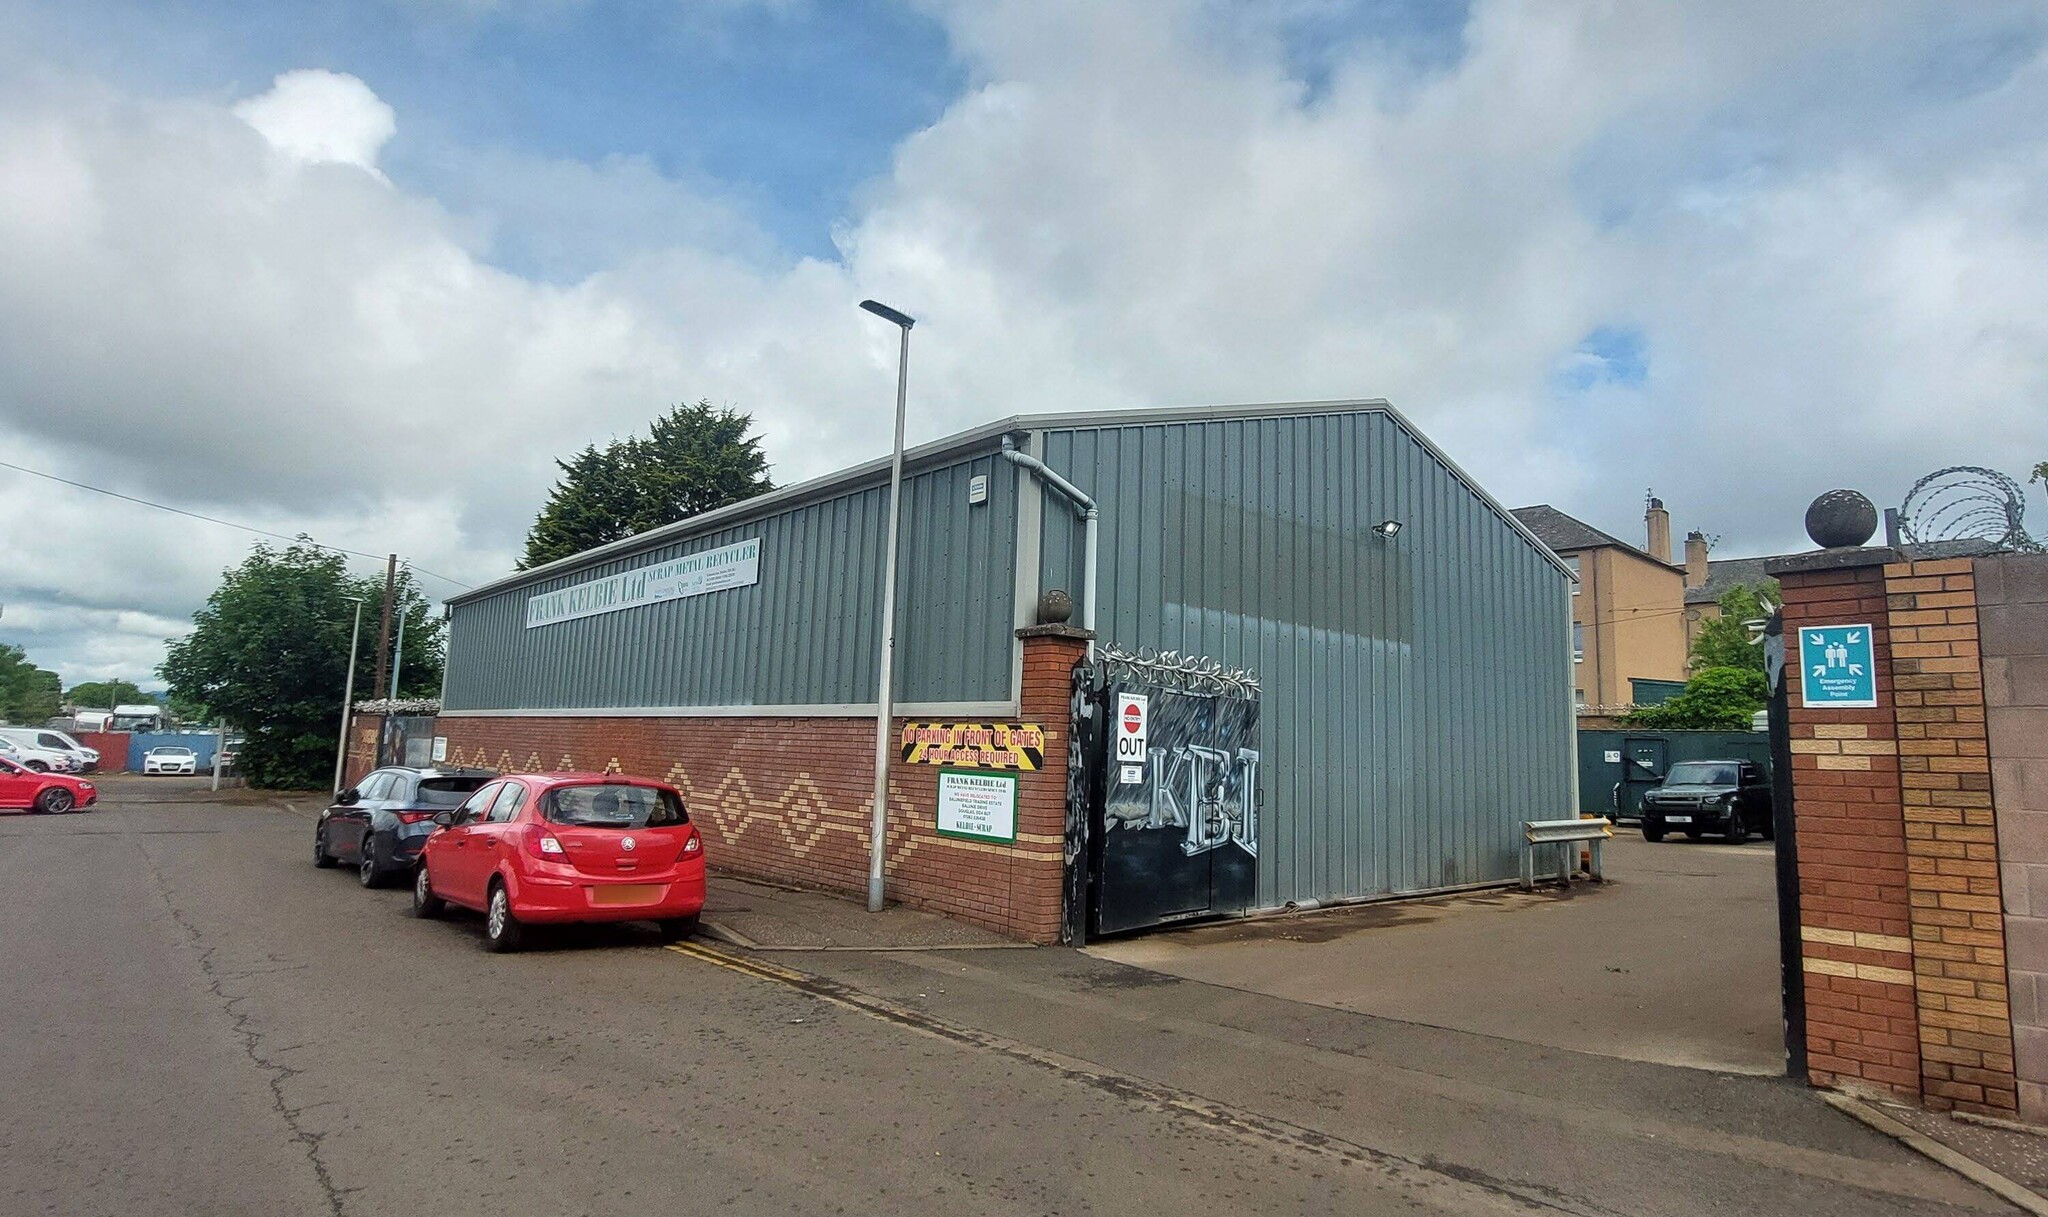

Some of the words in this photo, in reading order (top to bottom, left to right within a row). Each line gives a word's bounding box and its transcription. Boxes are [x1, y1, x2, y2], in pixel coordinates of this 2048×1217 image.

[648, 566, 674, 582] SCRAP
[675, 558, 704, 576] METAL
[706, 545, 756, 568] RECYCLER
[528, 593, 565, 622] FRANK
[568, 579, 617, 614] KELBIE
[622, 571, 647, 602] Ltd
[904, 728, 914, 744] NO
[916, 728, 951, 745] PARKING
[954, 730, 963, 745] IN
[965, 729, 993, 746] FRONT
[996, 731, 1007, 747] OF
[1010, 731, 1041, 748] GATES
[1120, 737, 1144, 756] OUT
[919, 748, 928, 760] 24
[930, 749, 949, 761] HOUR
[950, 750, 979, 762] ACCESS
[980, 751, 1019, 764] REQUIRED
[947, 777, 968, 785] FRANK
[970, 778, 994, 787] KELBIE
